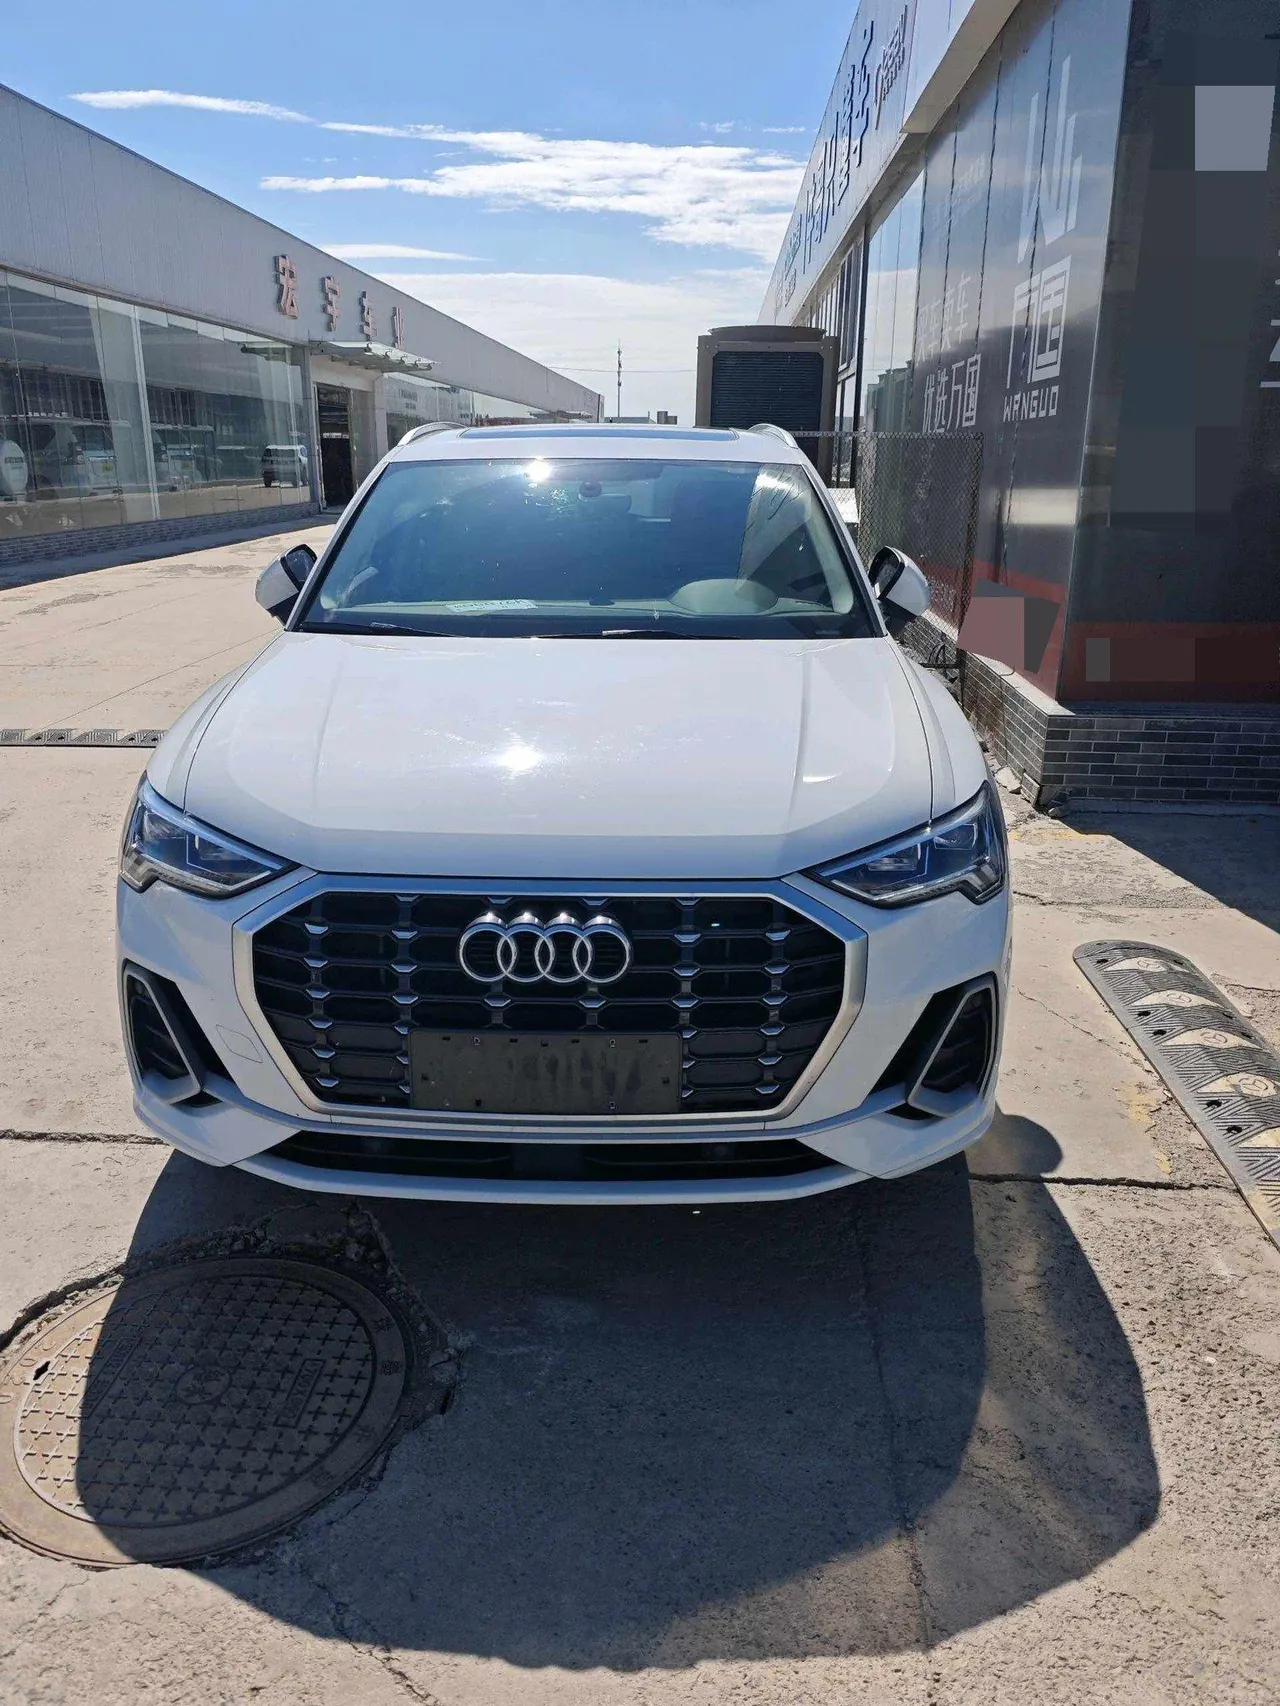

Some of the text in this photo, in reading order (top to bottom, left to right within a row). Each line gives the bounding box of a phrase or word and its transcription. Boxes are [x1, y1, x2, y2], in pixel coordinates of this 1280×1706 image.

[923, 354, 981, 433] 优选万国
[1002, 385, 1059, 422] WANGUO
